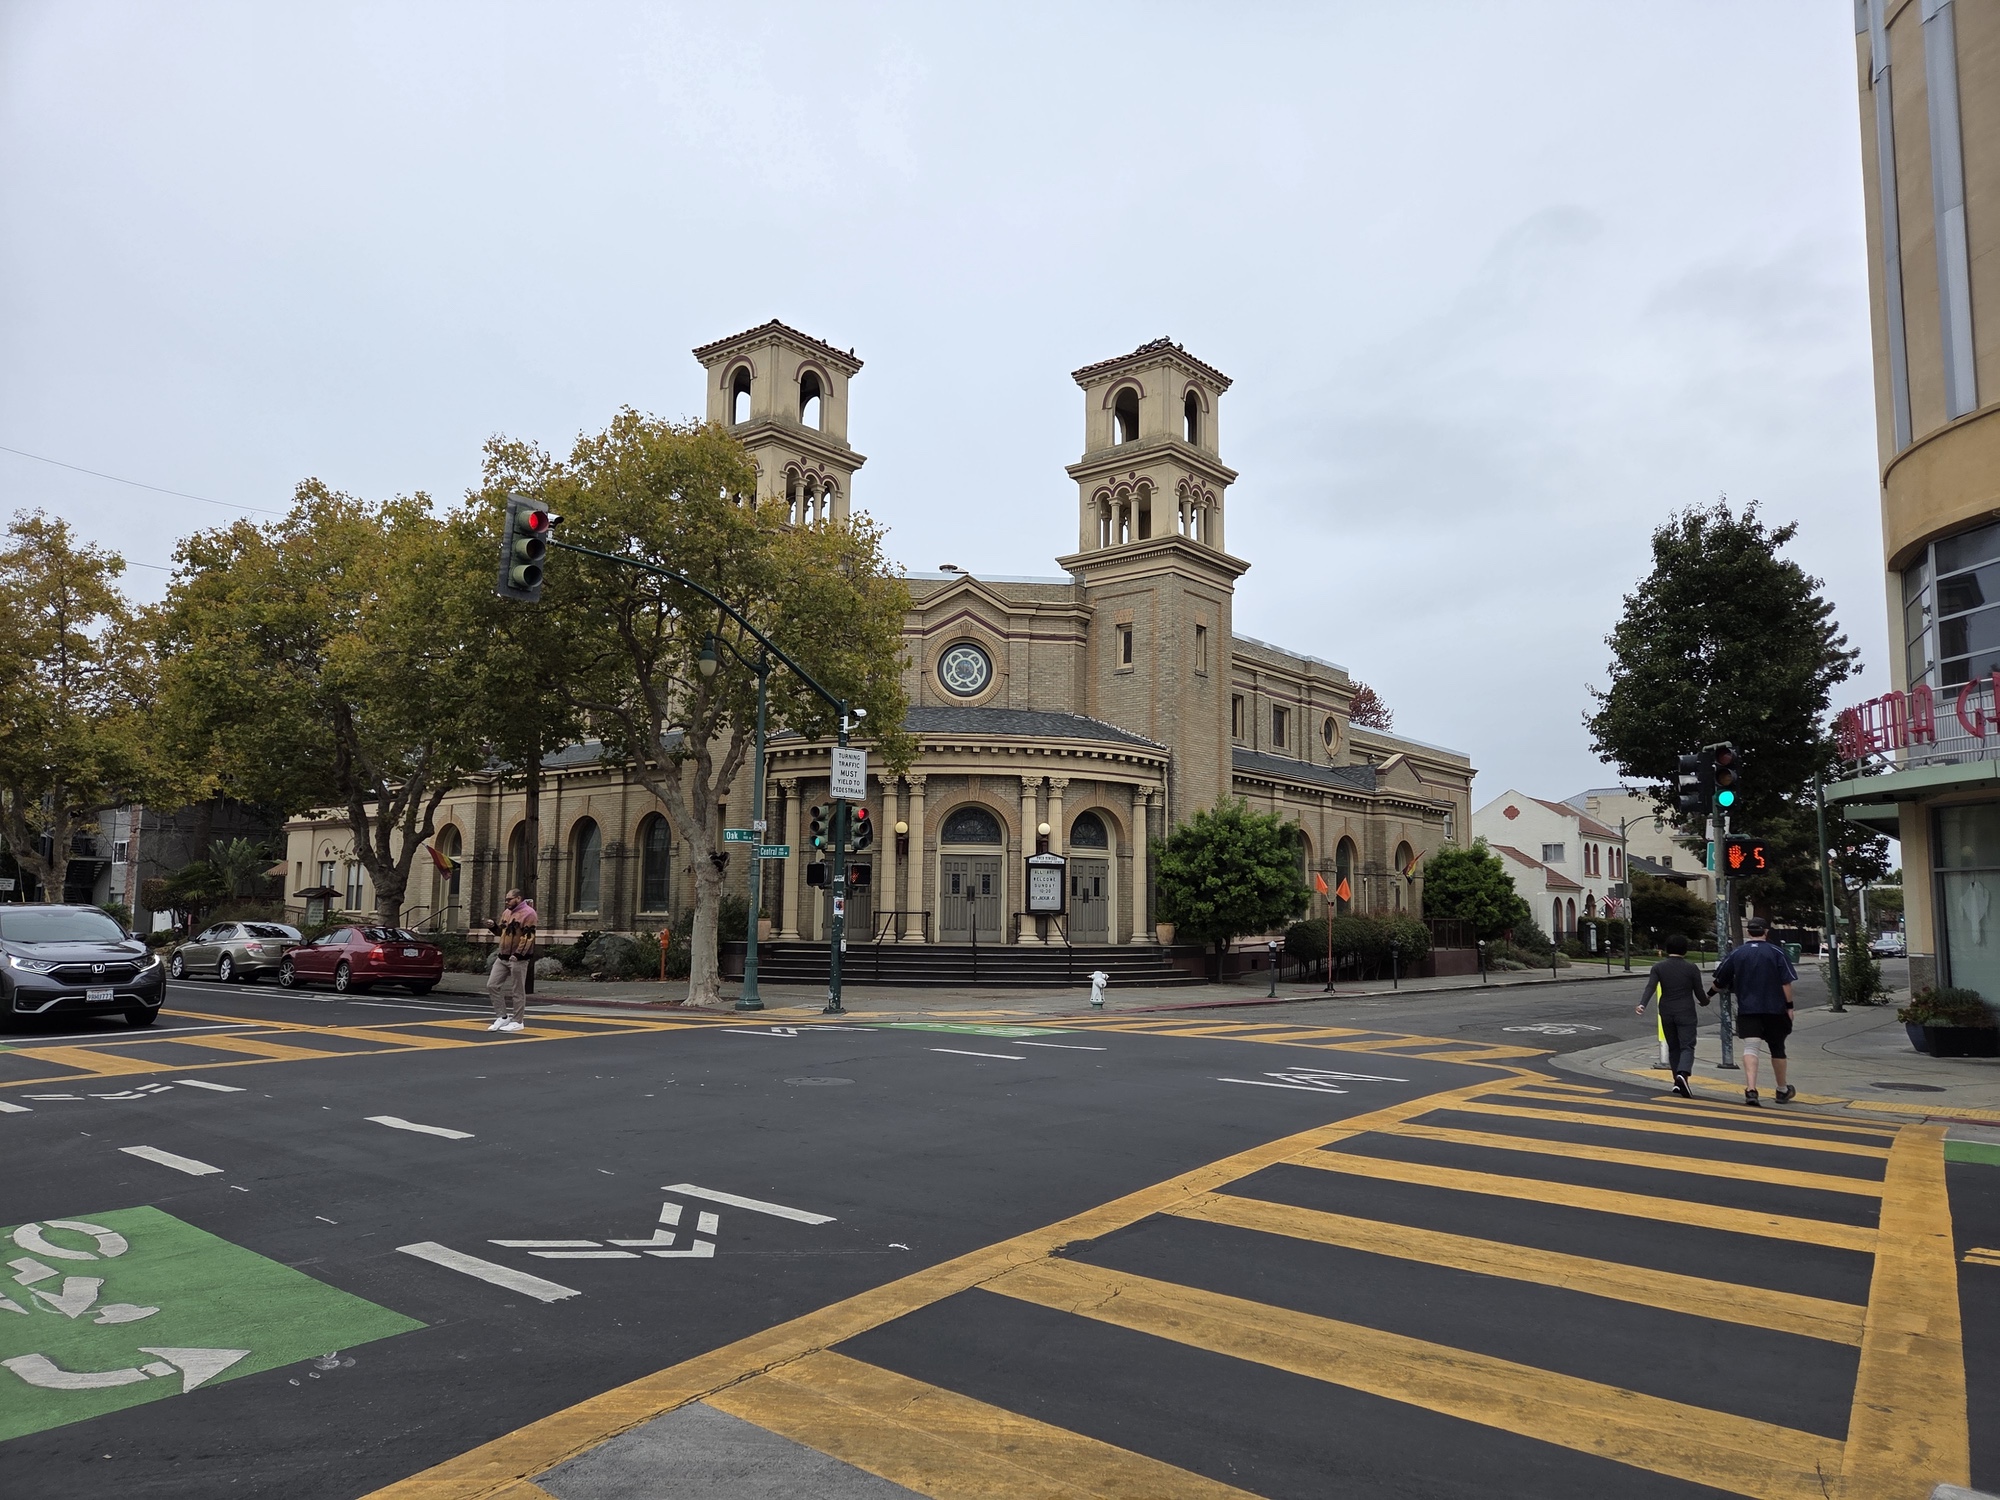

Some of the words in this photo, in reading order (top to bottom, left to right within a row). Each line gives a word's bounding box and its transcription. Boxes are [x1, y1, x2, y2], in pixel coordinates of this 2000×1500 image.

[838, 752, 861, 760] TURNING
[838, 760, 860, 769] TRAFFIC
[840, 769, 858, 778] MUST
[837, 778, 853, 786] YIELD
[853, 779, 861, 787] TO
[832, 786, 864, 795] PEDESTRIANS
[726, 831, 739, 840] Oak
[760, 847, 778, 856] Central
[1753, 847, 1765, 869] 5
